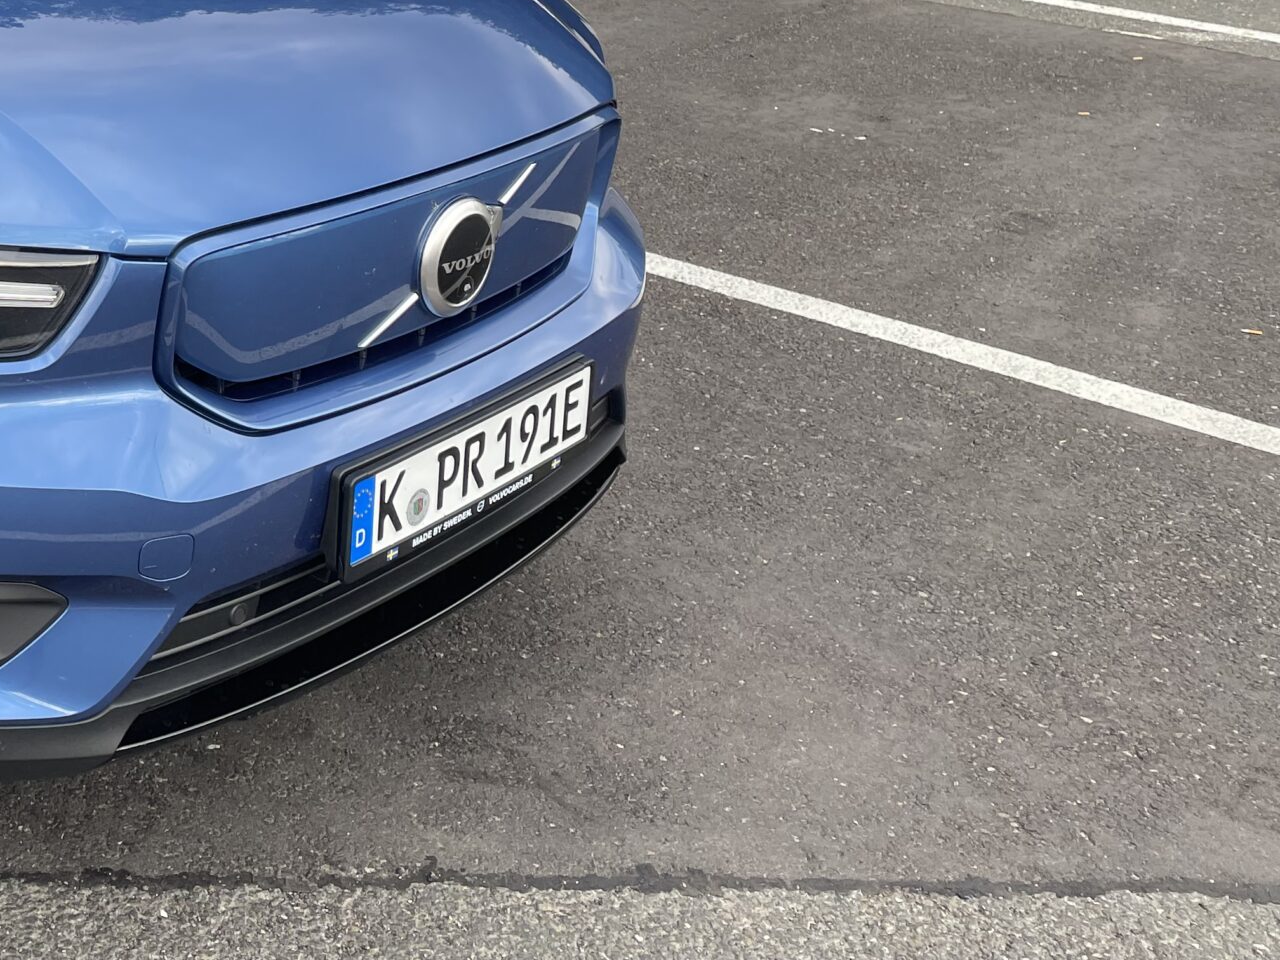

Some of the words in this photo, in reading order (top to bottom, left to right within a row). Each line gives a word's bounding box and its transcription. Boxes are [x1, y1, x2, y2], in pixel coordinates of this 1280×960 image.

[441, 247, 491, 274] VOLVO
[377, 469, 406, 542] K
[437, 431, 486, 511] PR
[494, 378, 584, 480] 191E
[488, 473, 534, 505] VOLVOCARS.DE
[355, 528, 366, 548] D
[412, 531, 433, 548] MADE
[433, 525, 443, 538] BY
